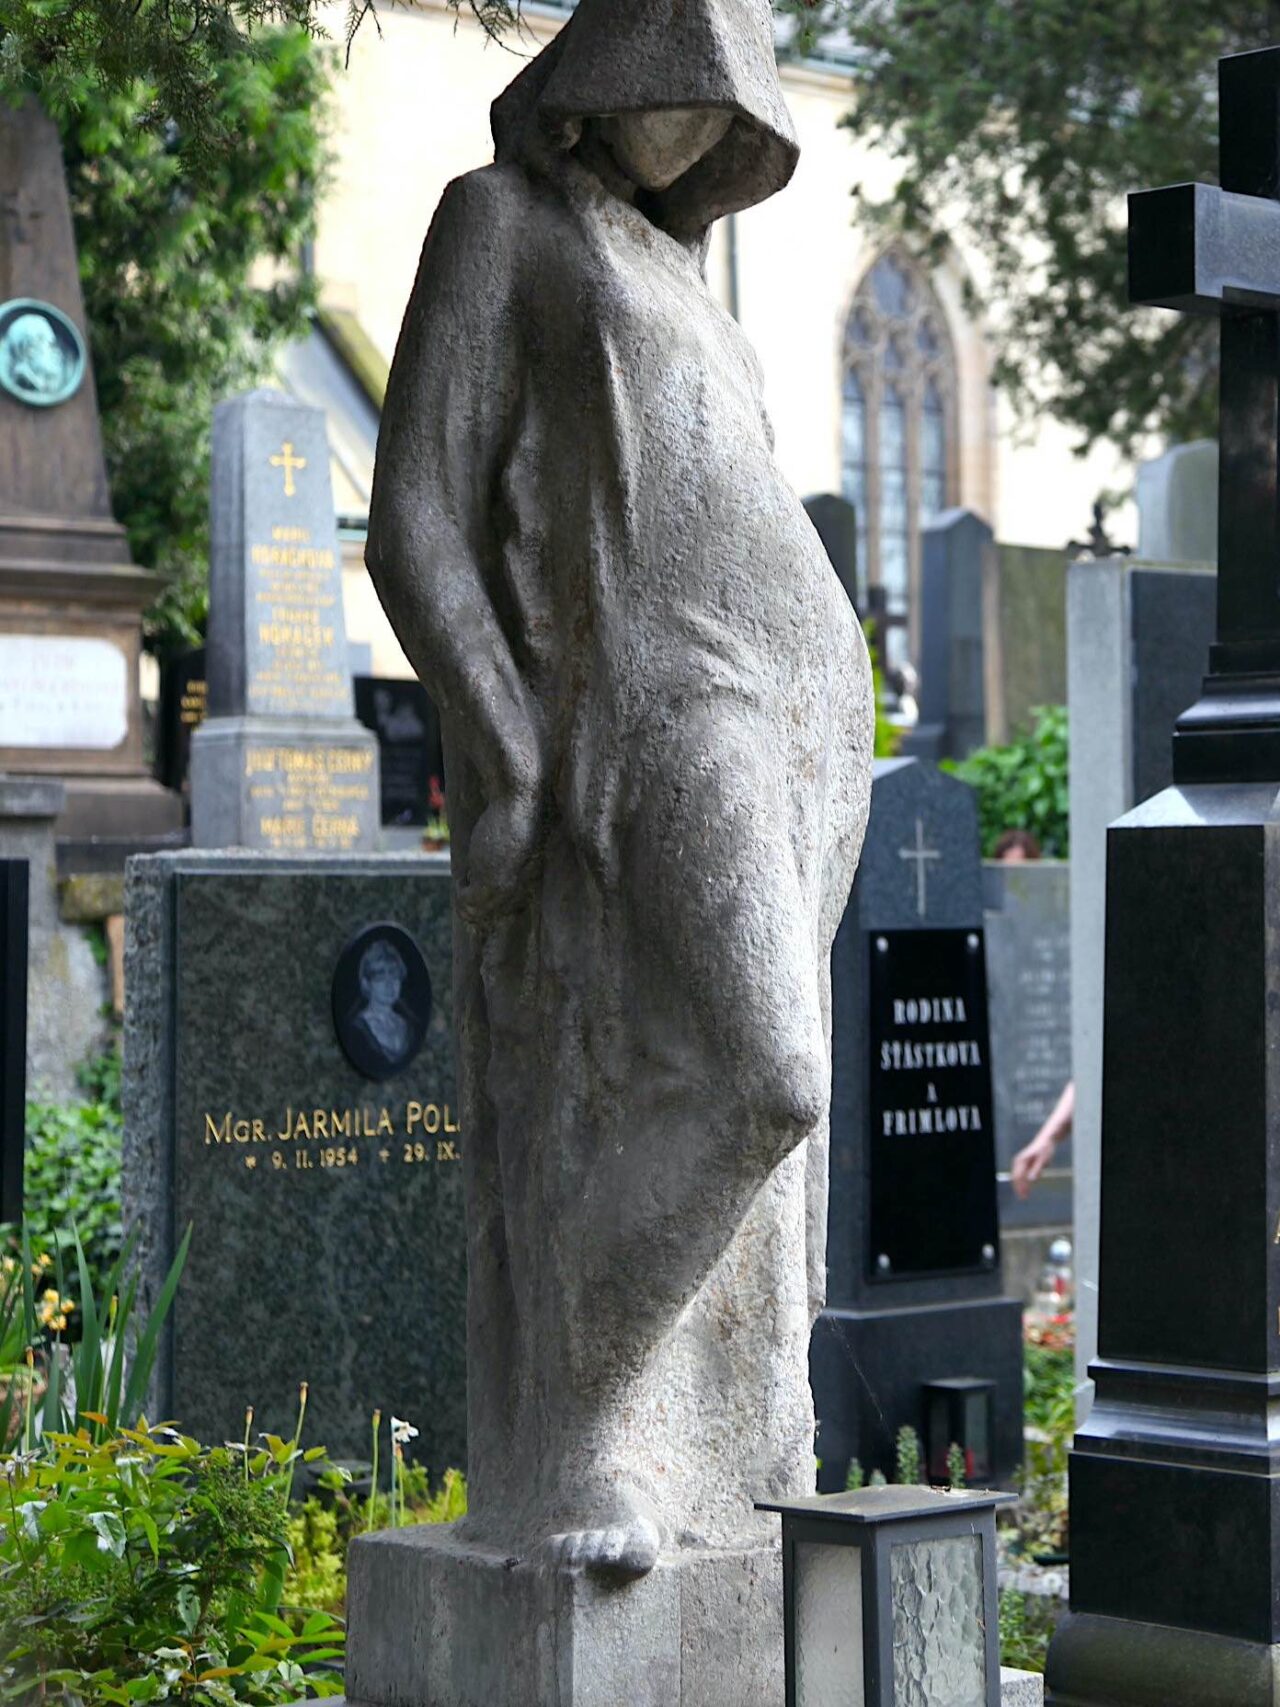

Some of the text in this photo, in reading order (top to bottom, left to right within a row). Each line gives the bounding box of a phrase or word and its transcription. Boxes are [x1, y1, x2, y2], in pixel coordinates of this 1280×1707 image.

[893, 996, 967, 1024] RODINA
[927, 1081, 938, 1103] A
[277, 1105, 394, 1141] JARMILA
[406, 1101, 461, 1135] POL
